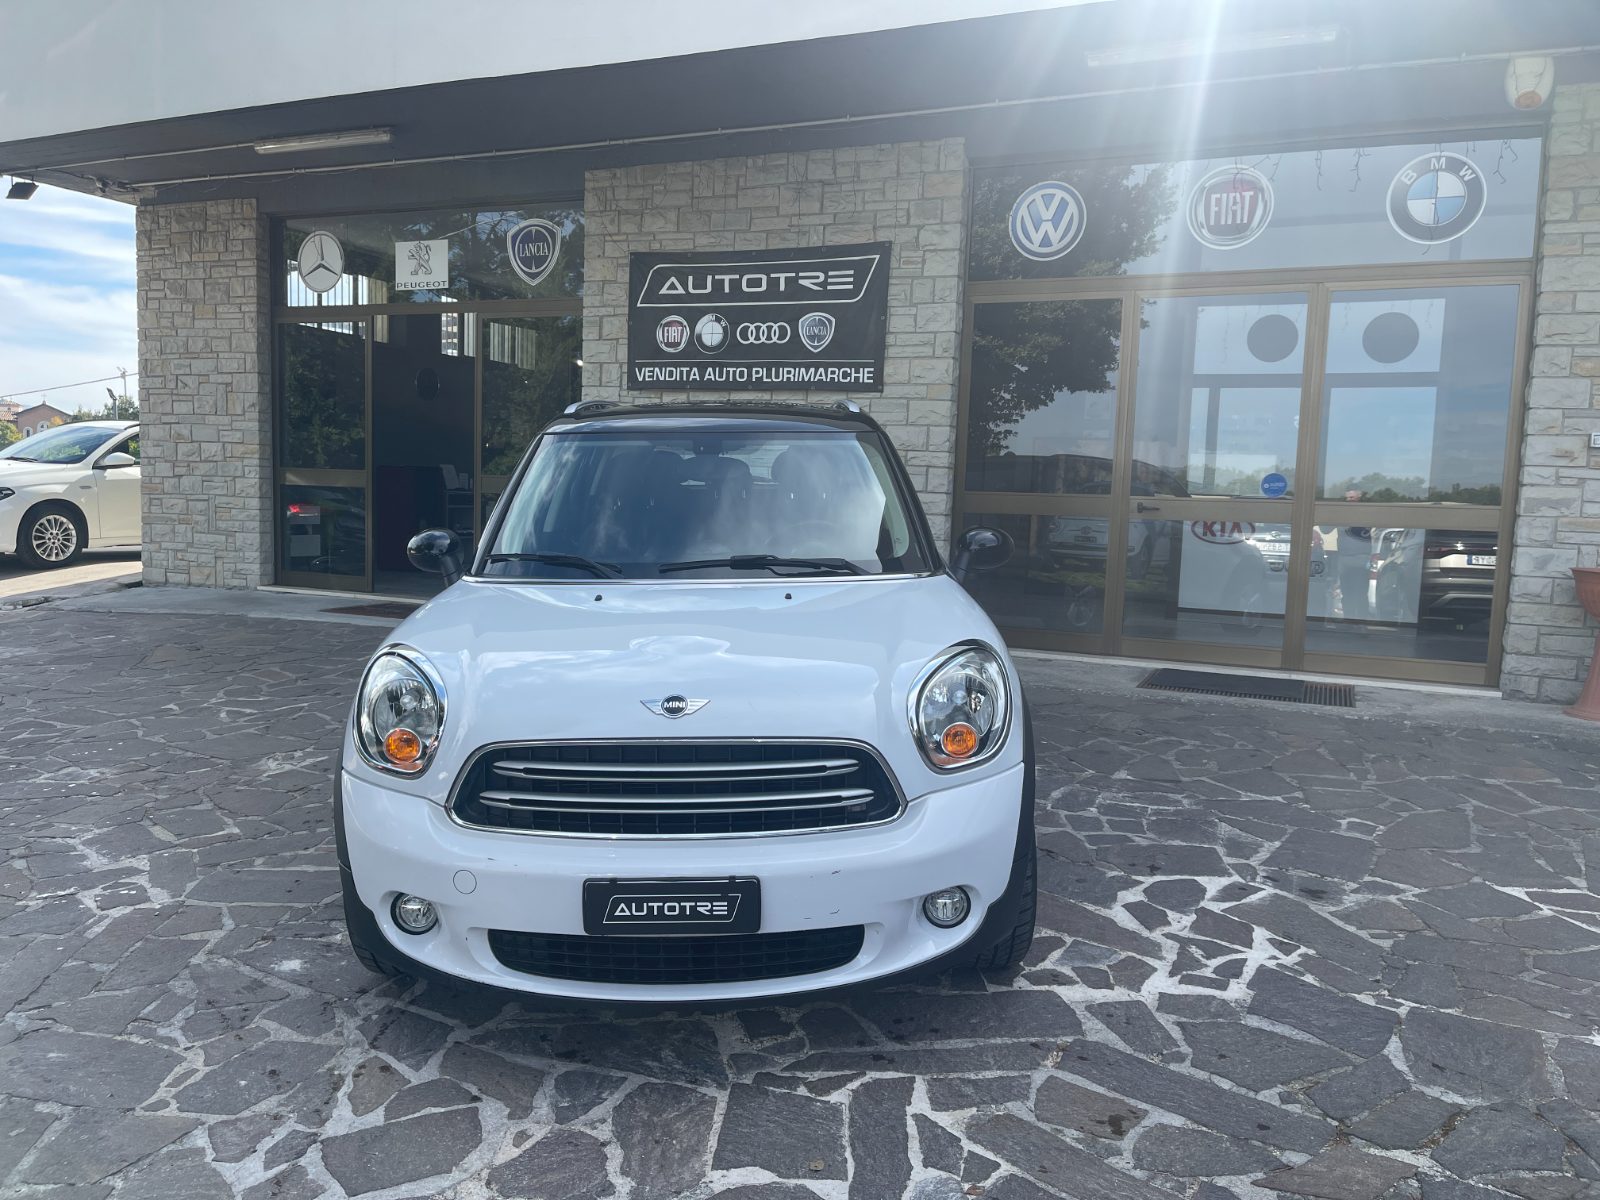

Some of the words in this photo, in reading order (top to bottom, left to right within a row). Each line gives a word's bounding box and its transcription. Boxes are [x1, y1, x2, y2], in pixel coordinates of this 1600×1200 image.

[1400, 156, 1477, 185] BMW
[1209, 191, 1254, 225] FIAT
[519, 241, 549, 257] LANCIA
[396, 280, 447, 289] PEUGEOT
[658, 269, 855, 295] AUTOTRE
[664, 326, 683, 343] FIAT
[806, 326, 827, 336] LANCIA
[635, 367, 700, 382] VENDITA
[704, 367, 748, 382] AUTO
[752, 367, 874, 383] PLURIMARCHE
[1203, 521, 1243, 537] KIA
[663, 700, 686, 709] MINI
[614, 901, 728, 916] AUTOTRE
